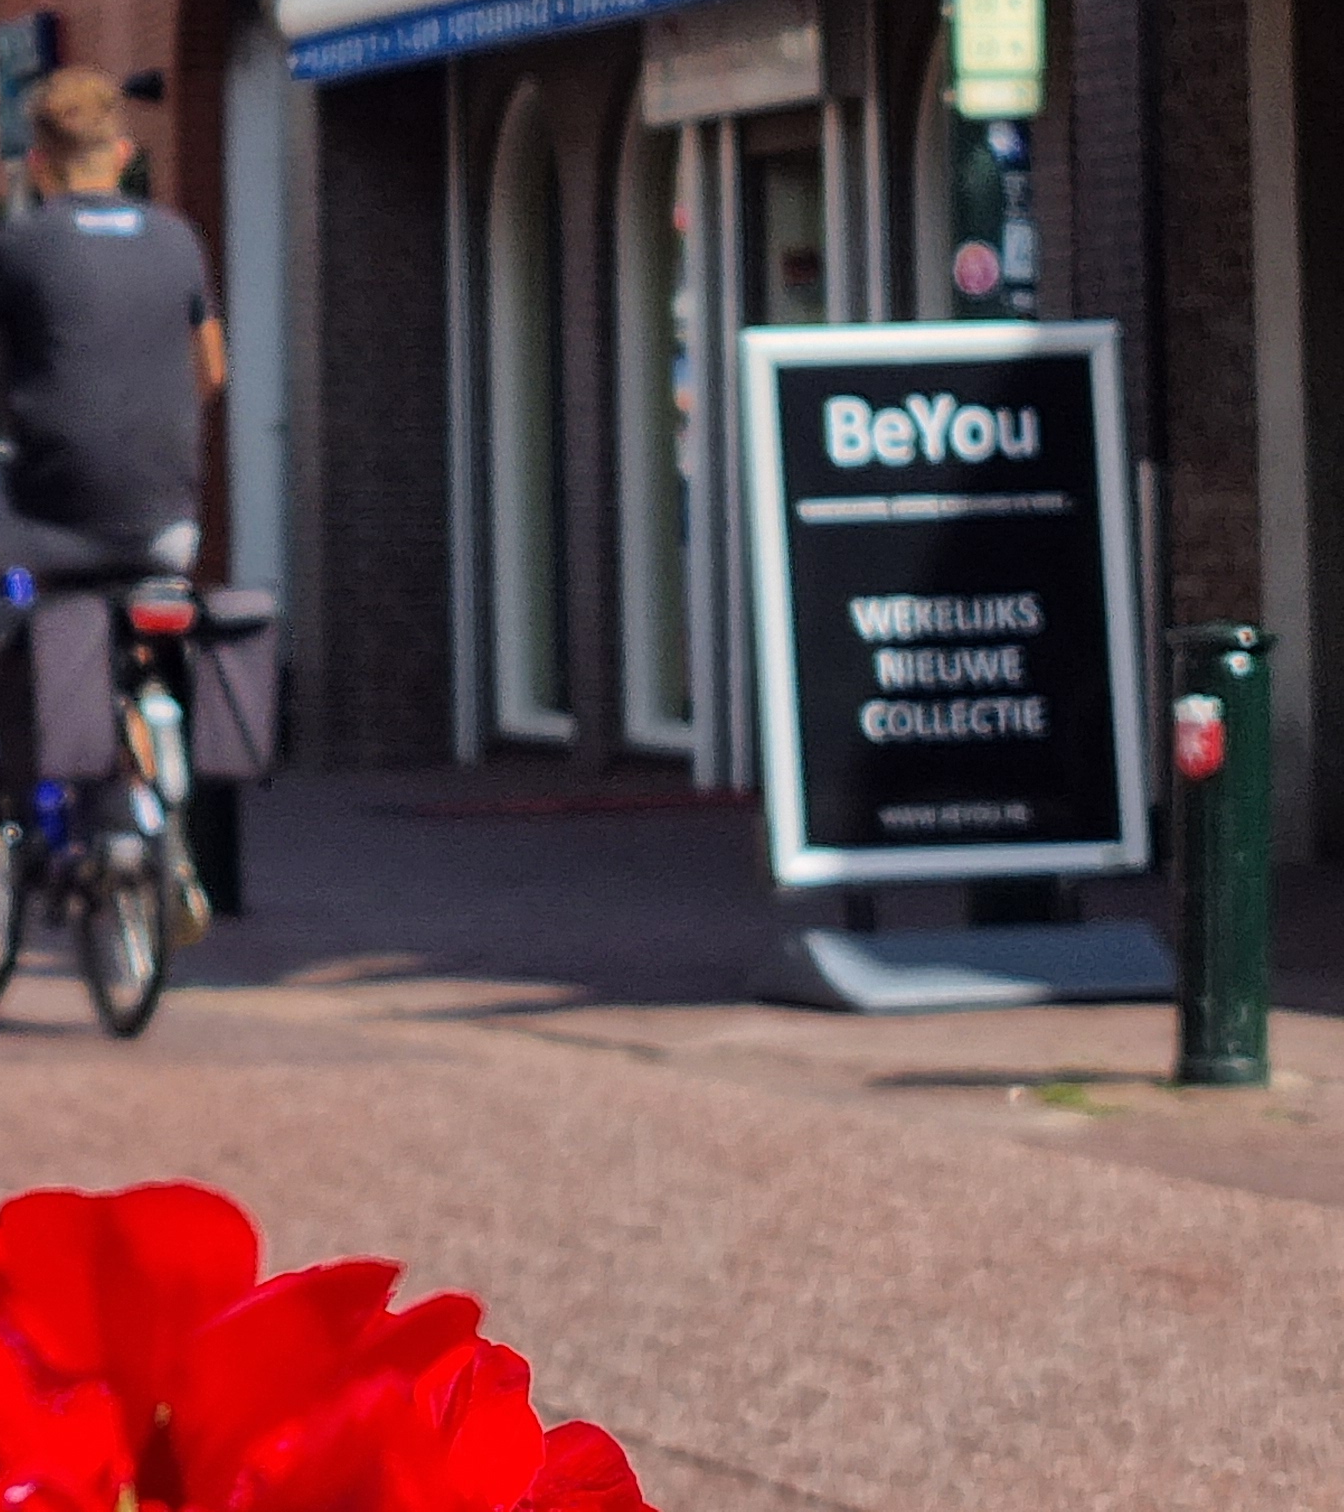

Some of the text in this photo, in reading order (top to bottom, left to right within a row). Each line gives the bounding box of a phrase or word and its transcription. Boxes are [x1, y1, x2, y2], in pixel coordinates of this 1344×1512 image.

[825, 393, 1041, 467] BeYou
[850, 593, 1043, 641] WEKELIJKS
[875, 646, 1027, 688] NIEUWE
[859, 696, 1050, 744] COLLECTIE
